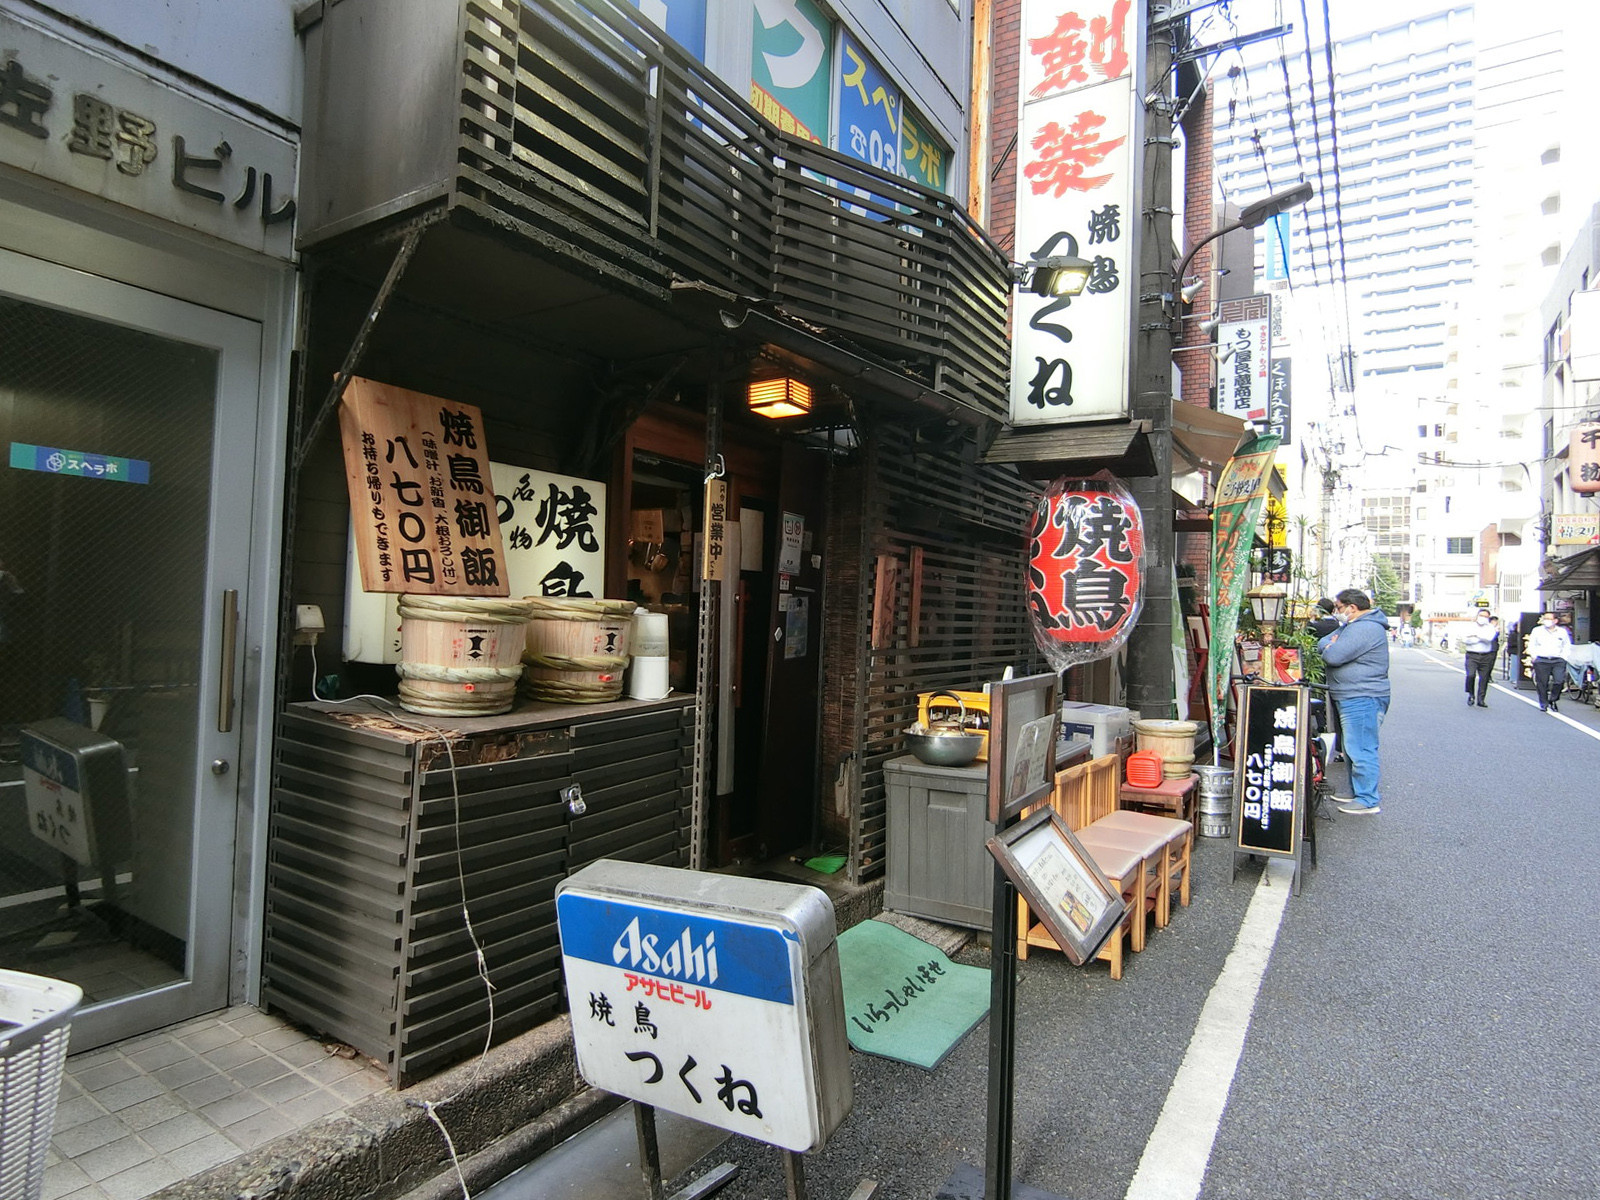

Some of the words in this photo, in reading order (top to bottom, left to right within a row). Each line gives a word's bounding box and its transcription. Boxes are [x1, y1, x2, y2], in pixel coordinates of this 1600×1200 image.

[1087, 204, 1120, 295] 焼鳥
[362, 431, 394, 583] お持ち帰りもできます
[439, 407, 499, 587] 焼鳥御飯
[511, 473, 535, 550] 名物
[1053, 496, 1134, 632] 焼鳥
[612, 915, 719, 985] Asahi
[588, 990, 658, 1040] 焼鳥
[624, 973, 712, 1011] アサヒビール
[624, 1050, 763, 1120] つくね
